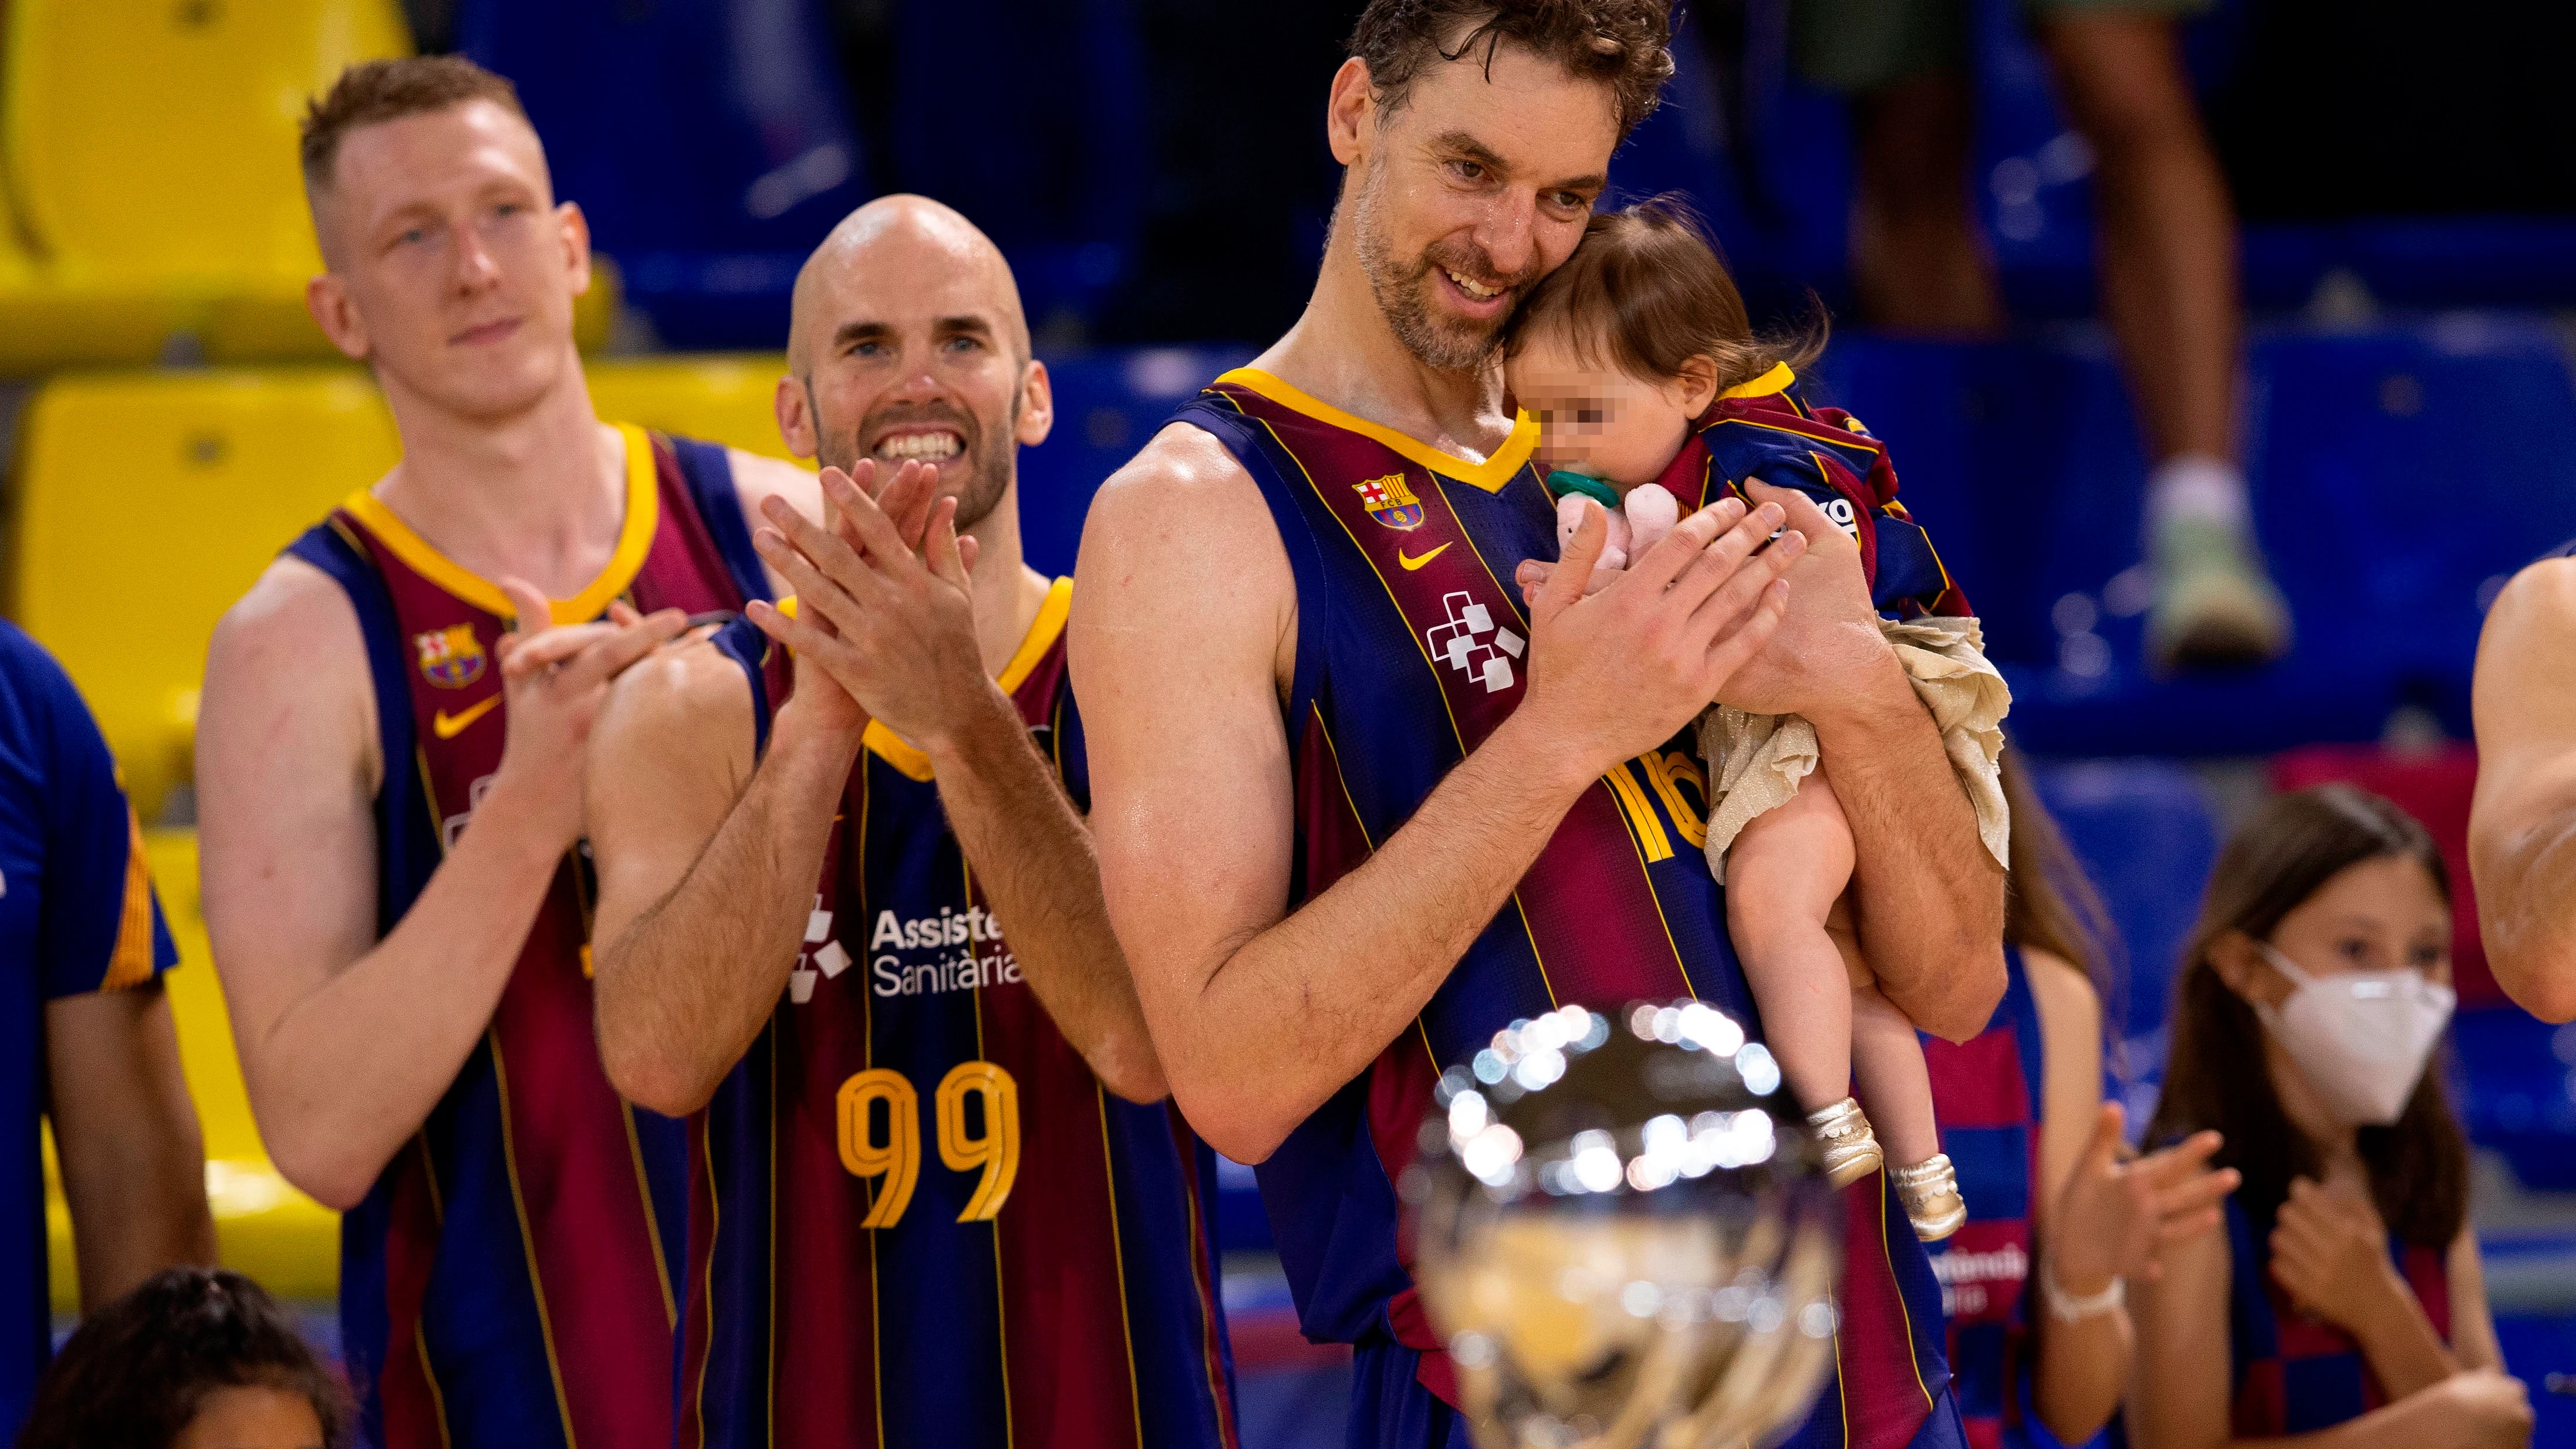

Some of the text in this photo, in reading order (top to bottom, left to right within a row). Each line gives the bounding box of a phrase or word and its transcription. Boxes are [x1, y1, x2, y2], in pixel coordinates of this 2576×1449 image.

[1380, 498, 1402, 508] FCB
[874, 945, 1024, 997] Sanitària
[836, 1060, 1021, 1228] 99
